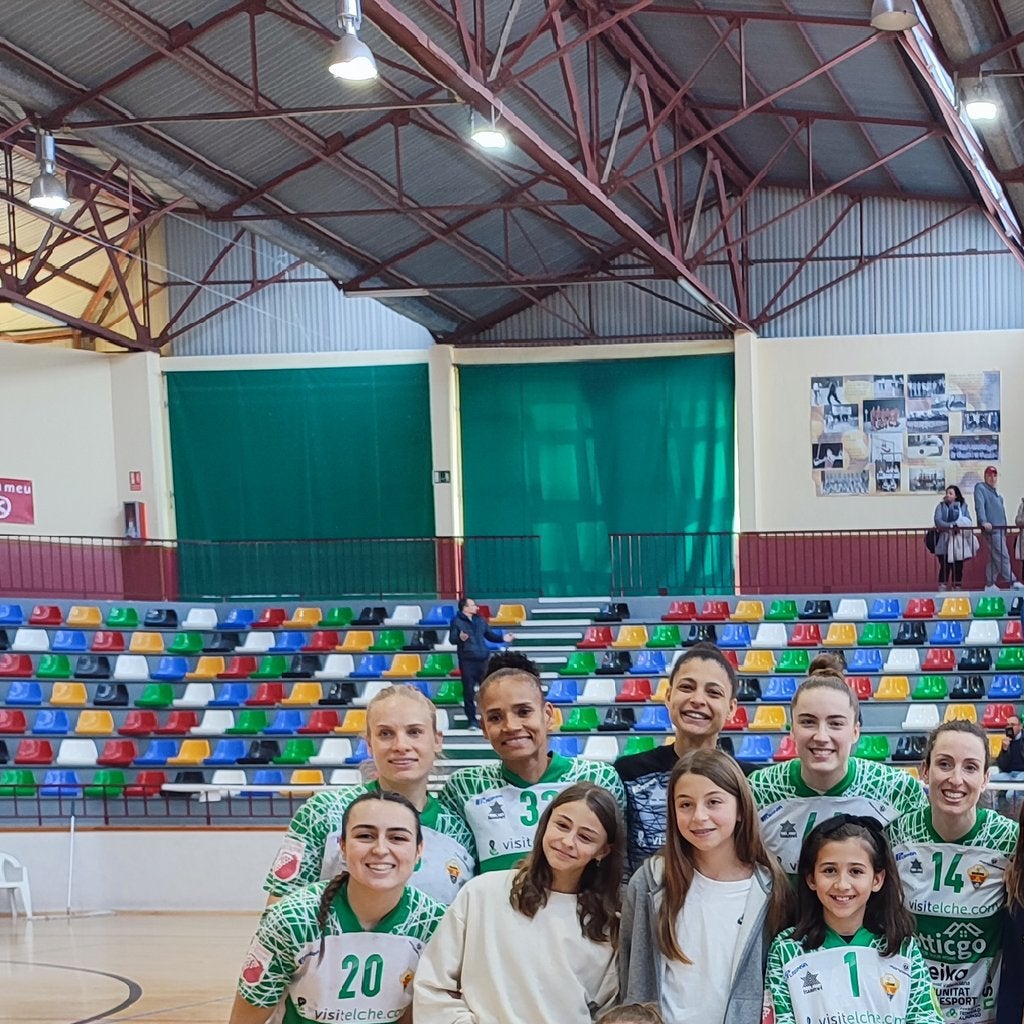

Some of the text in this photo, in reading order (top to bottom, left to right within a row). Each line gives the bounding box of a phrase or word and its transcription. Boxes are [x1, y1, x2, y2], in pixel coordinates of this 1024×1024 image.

[4, 483, 32, 495] meu
[931, 851, 965, 893] 14
[908, 900, 1000, 915] visitelche.com
[338, 954, 384, 1000] 20
[843, 951, 861, 998] 1
